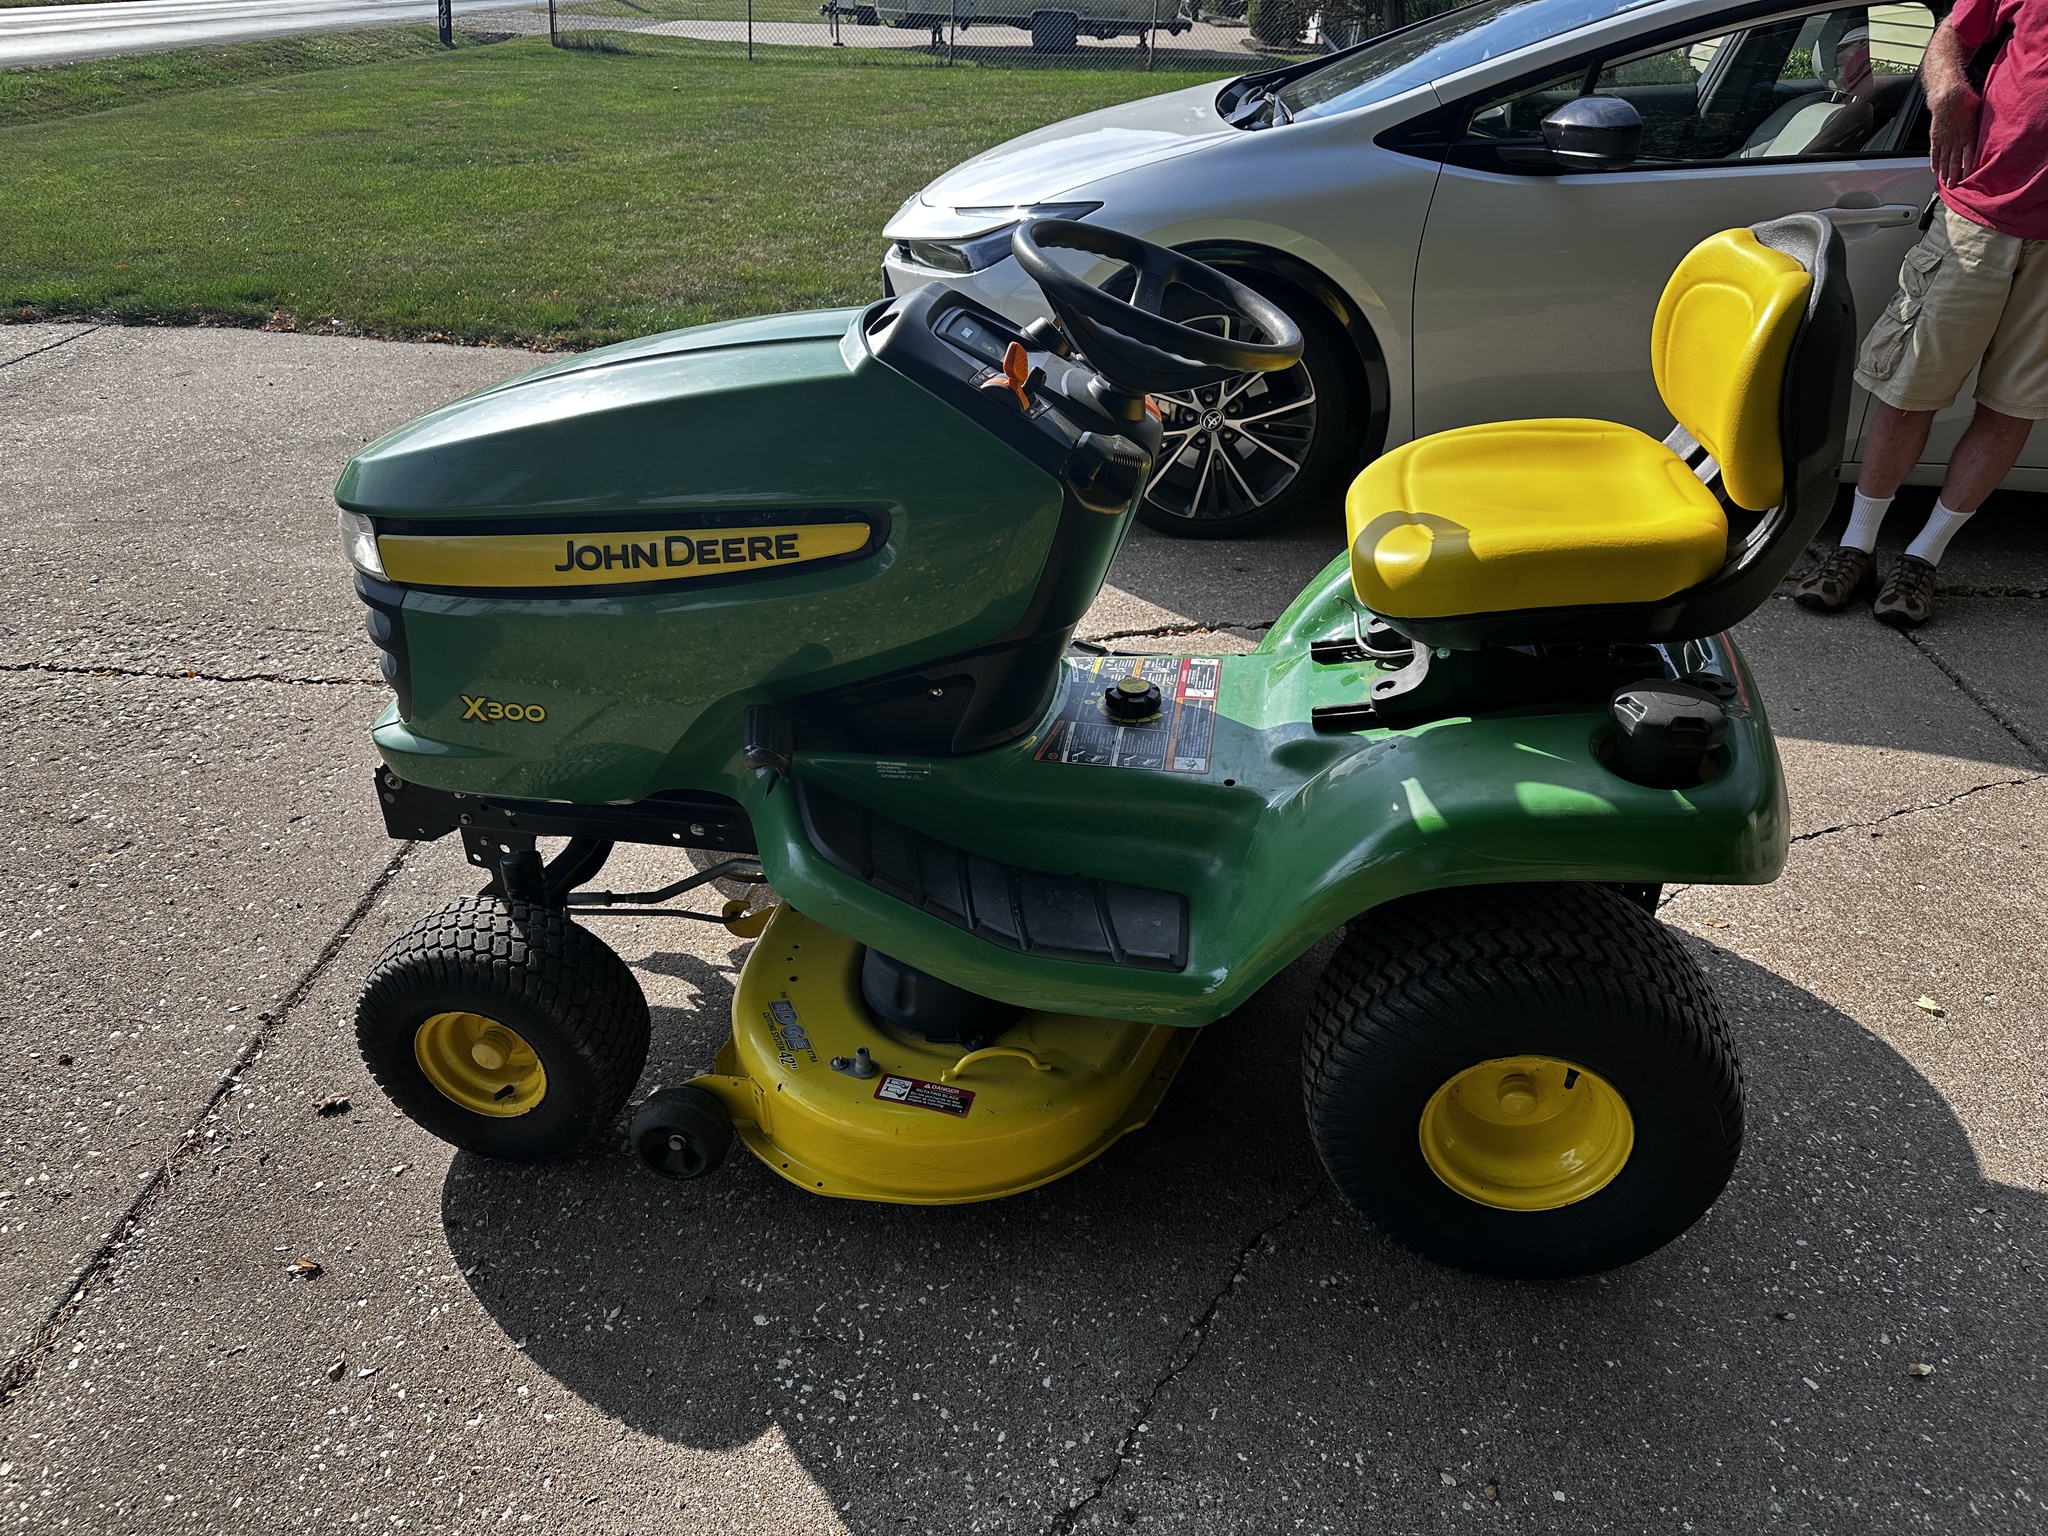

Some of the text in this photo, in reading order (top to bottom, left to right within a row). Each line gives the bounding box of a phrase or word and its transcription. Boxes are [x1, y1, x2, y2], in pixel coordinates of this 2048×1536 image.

[554, 533, 800, 571] JOHN DEERE
[459, 694, 547, 723] X300
[762, 1012, 778, 1032] CUTTING
[771, 1031, 787, 1051] SYSTEM
[768, 991, 818, 1063] THE EDGE XTRA
[915, 1088, 960, 1101] ROTATING BLADE
[931, 1084, 960, 1095] DANGER
